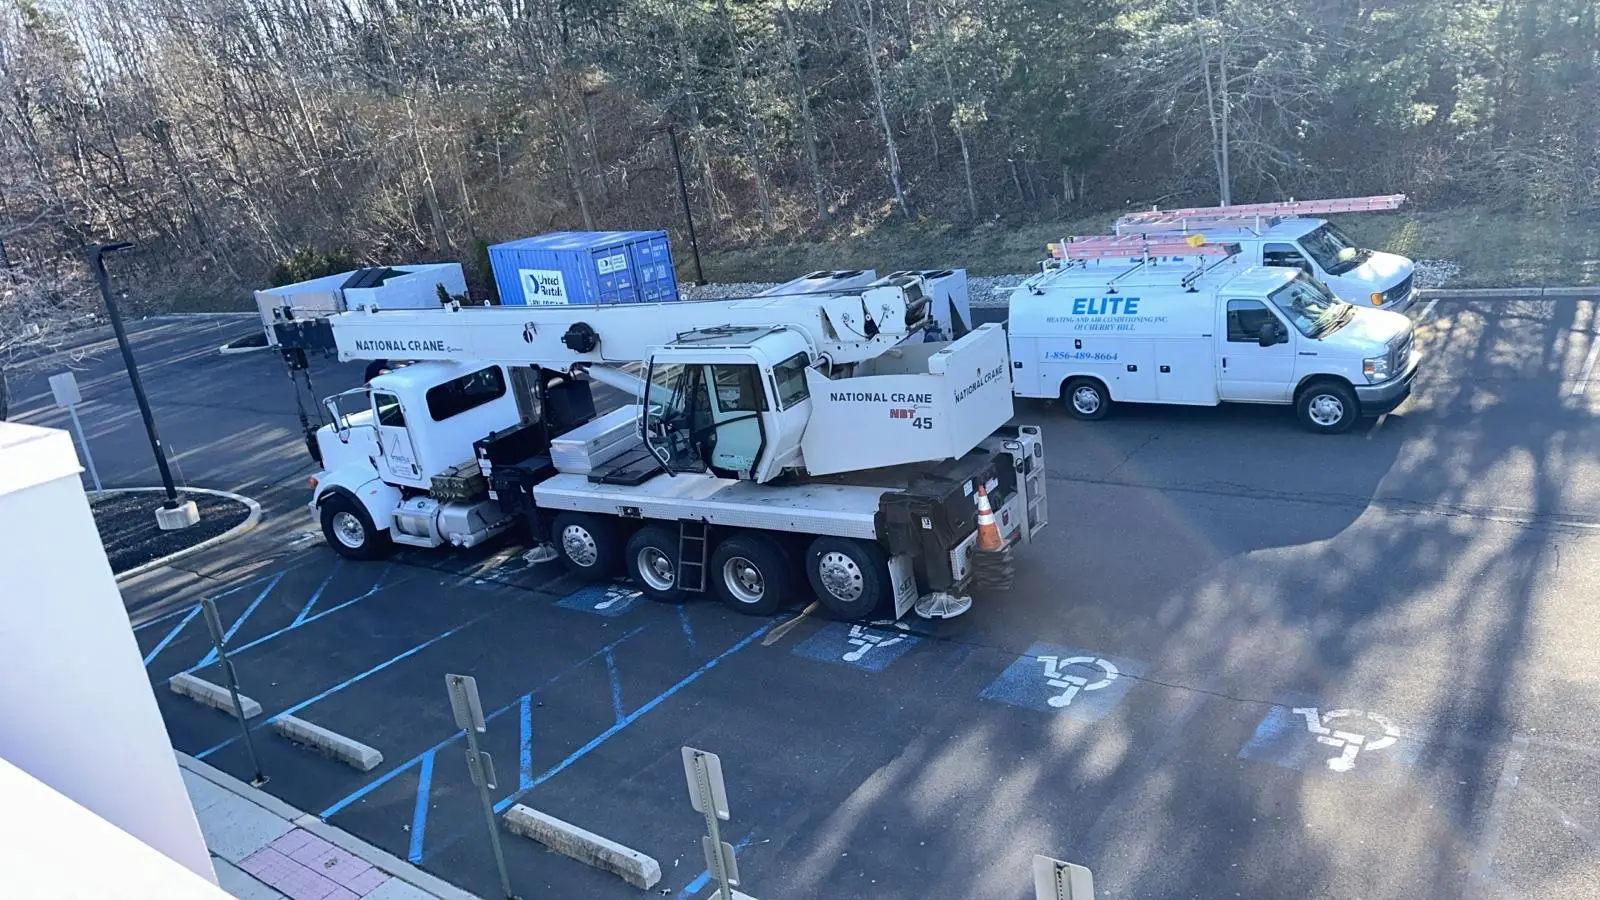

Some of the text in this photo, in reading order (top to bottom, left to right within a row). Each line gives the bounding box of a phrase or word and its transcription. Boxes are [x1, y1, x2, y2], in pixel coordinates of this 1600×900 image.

[540, 286, 563, 297] Rentals
[1072, 297, 1140, 315] ELITE
[1046, 316, 1075, 324] HEATING
[1076, 316, 1088, 324] AND
[1074, 323, 1082, 331] OF
[1081, 323, 1114, 331] CHERRY
[355, 340, 406, 351] NATIONAL
[407, 340, 445, 352] CRANE
[1045, 351, 1118, 361] 1-856-489-8664
[955, 365, 1003, 404] NATIONAL CRANE
[830, 392, 933, 404] NATIONAL CRANE
[889, 408, 916, 419] NBT
[912, 417, 933, 430] 45
